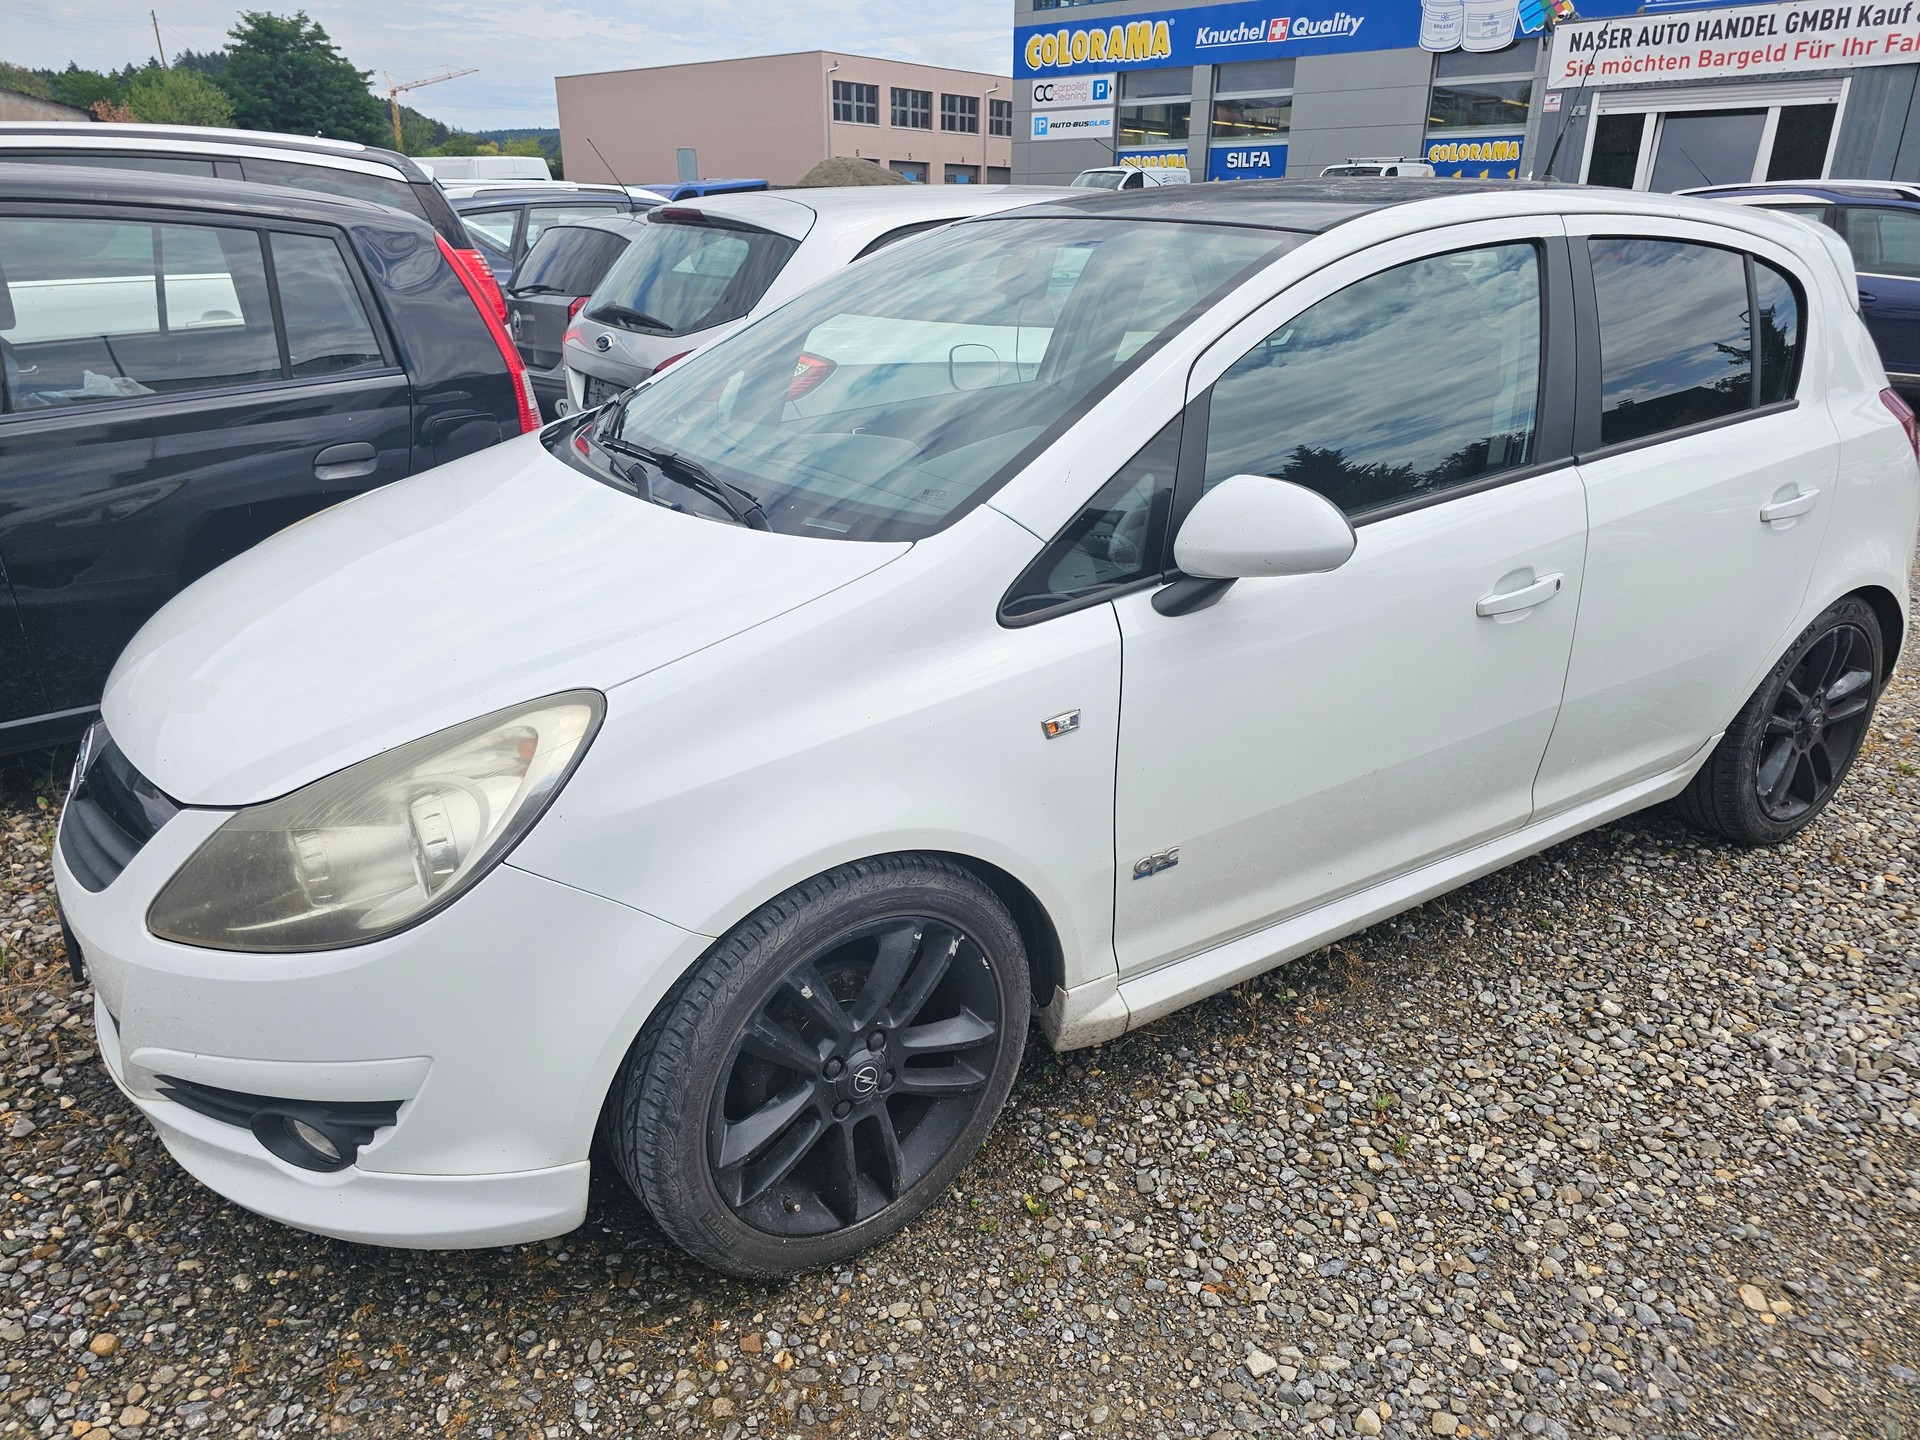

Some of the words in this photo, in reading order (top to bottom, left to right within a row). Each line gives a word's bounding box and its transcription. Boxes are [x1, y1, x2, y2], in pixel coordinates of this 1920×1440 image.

[1195, 20, 1267, 45] Knuchel
[1292, 12, 1365, 37] Quality
[1569, 27, 1633, 53] NASER
[1636, 22, 1690, 48] AUTO
[1695, 14, 1778, 42] HANDEL
[1785, 6, 1852, 34] GMBH
[1856, 1, 1914, 28] Kauf
[1025, 20, 1172, 70] COLORAMA
[1565, 59, 1596, 78] Sie
[1601, 54, 1691, 75] möchten
[1698, 43, 1788, 70] Bargeld
[1793, 40, 1836, 61] Für
[1842, 37, 1879, 57] Ihr
[1052, 92, 1087, 101] Cleaning
[1053, 82, 1088, 93] Carpolish
[1096, 83, 1105, 98] P
[1575, 107, 1581, 115] 2
[1050, 119, 1110, 128] AUTO-BUSGLAS
[1226, 151, 1271, 168] SILFA
[1429, 141, 1520, 162] COLORAMA
[1775, 624, 1816, 679] NEXEN
